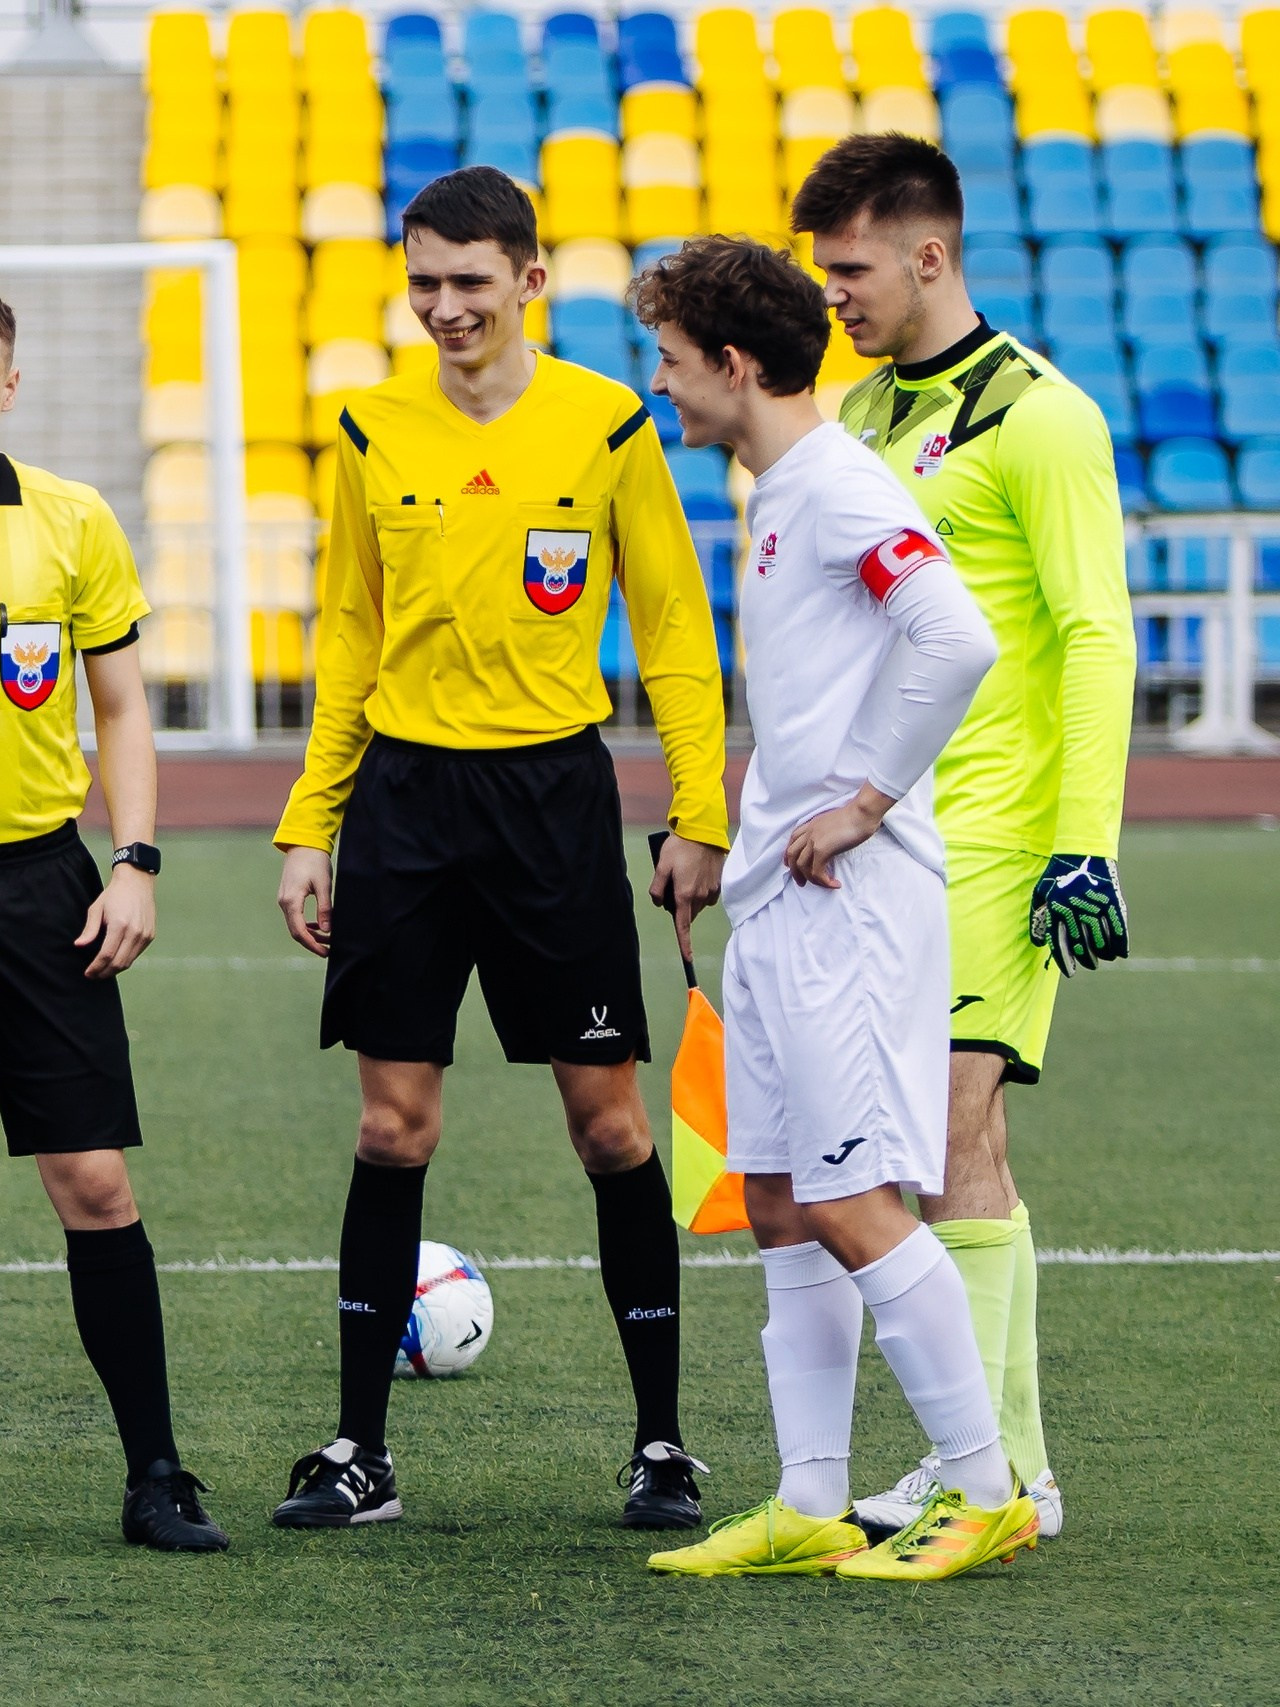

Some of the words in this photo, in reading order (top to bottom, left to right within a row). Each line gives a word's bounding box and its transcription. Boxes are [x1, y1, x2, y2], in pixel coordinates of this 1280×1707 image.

[460, 485, 500, 495] adidas
[877, 532, 925, 577] C
[580, 1027, 622, 1040] JÖGEL
[337, 1296, 377, 1313] ÖGEL
[624, 1306, 676, 1320] JÖGEL
